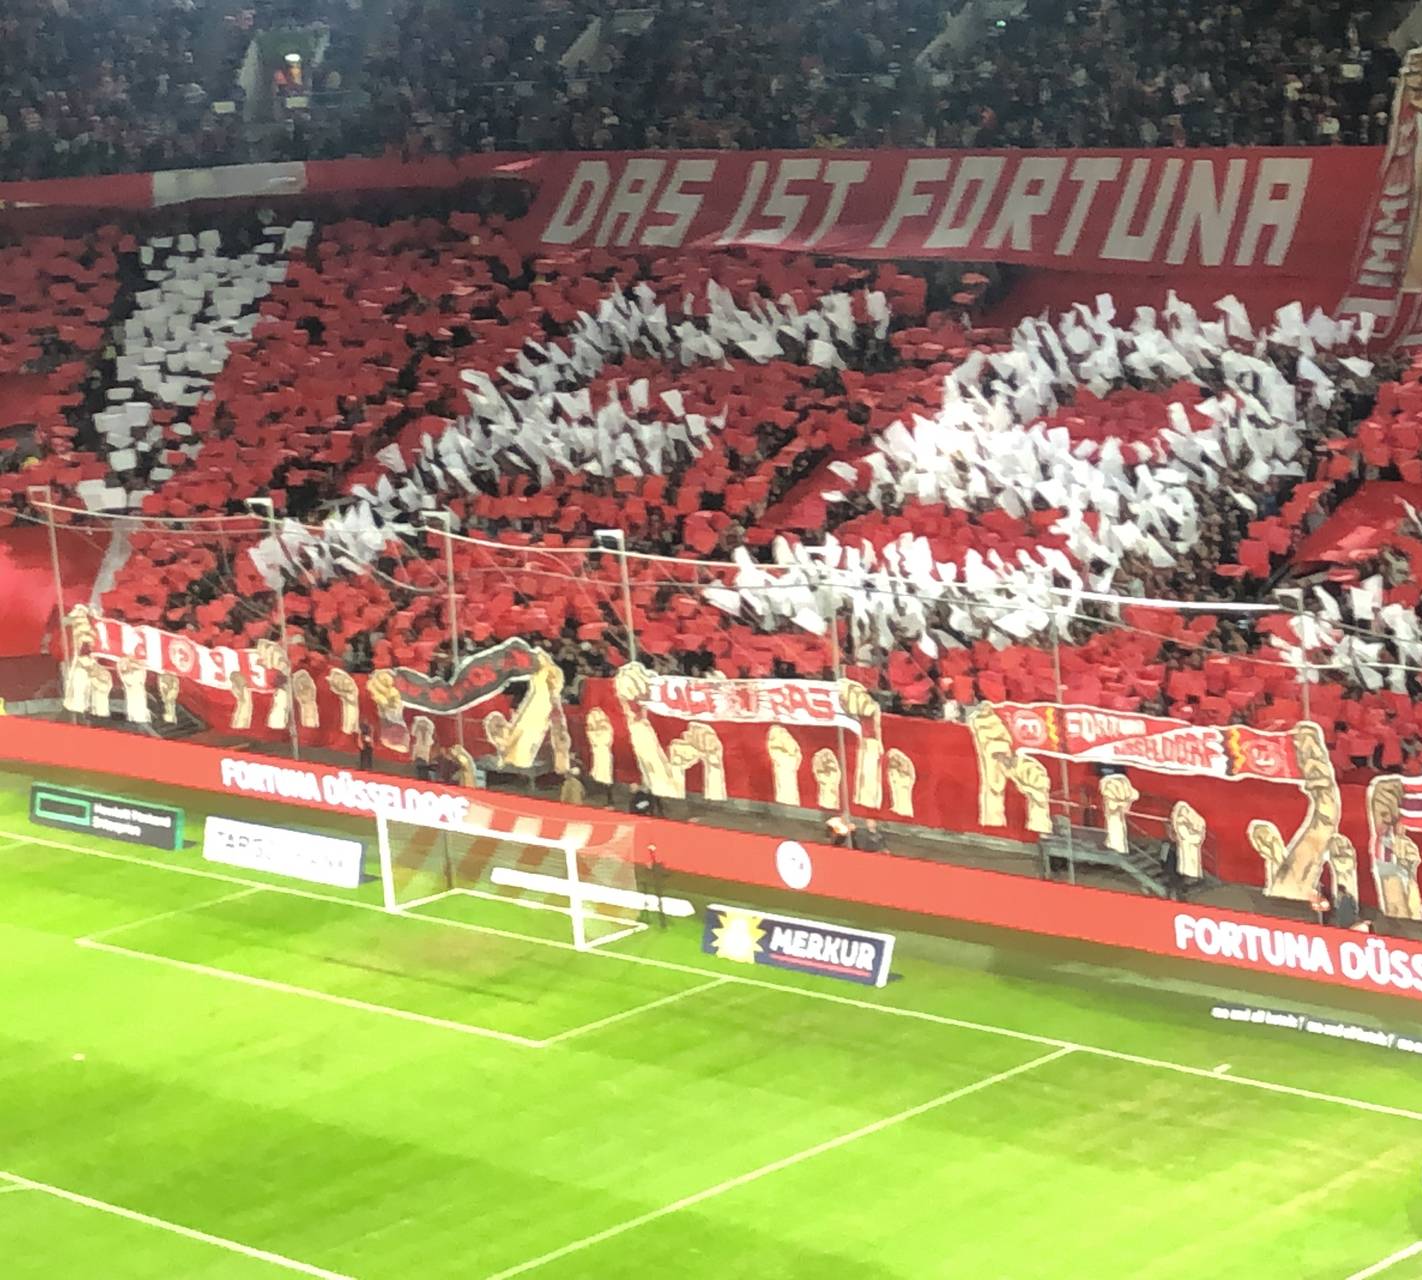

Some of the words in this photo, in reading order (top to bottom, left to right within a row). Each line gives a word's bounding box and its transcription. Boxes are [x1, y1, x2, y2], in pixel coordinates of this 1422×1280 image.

[541, 158, 717, 247] DAS
[712, 158, 870, 246] IST
[871, 156, 1313, 266] FORTUNA
[221, 758, 321, 802] FORTUNA
[322, 770, 470, 823] DÜSSELDORF
[768, 926, 876, 971] MERKUR
[1174, 913, 1334, 975] FORTUNA
